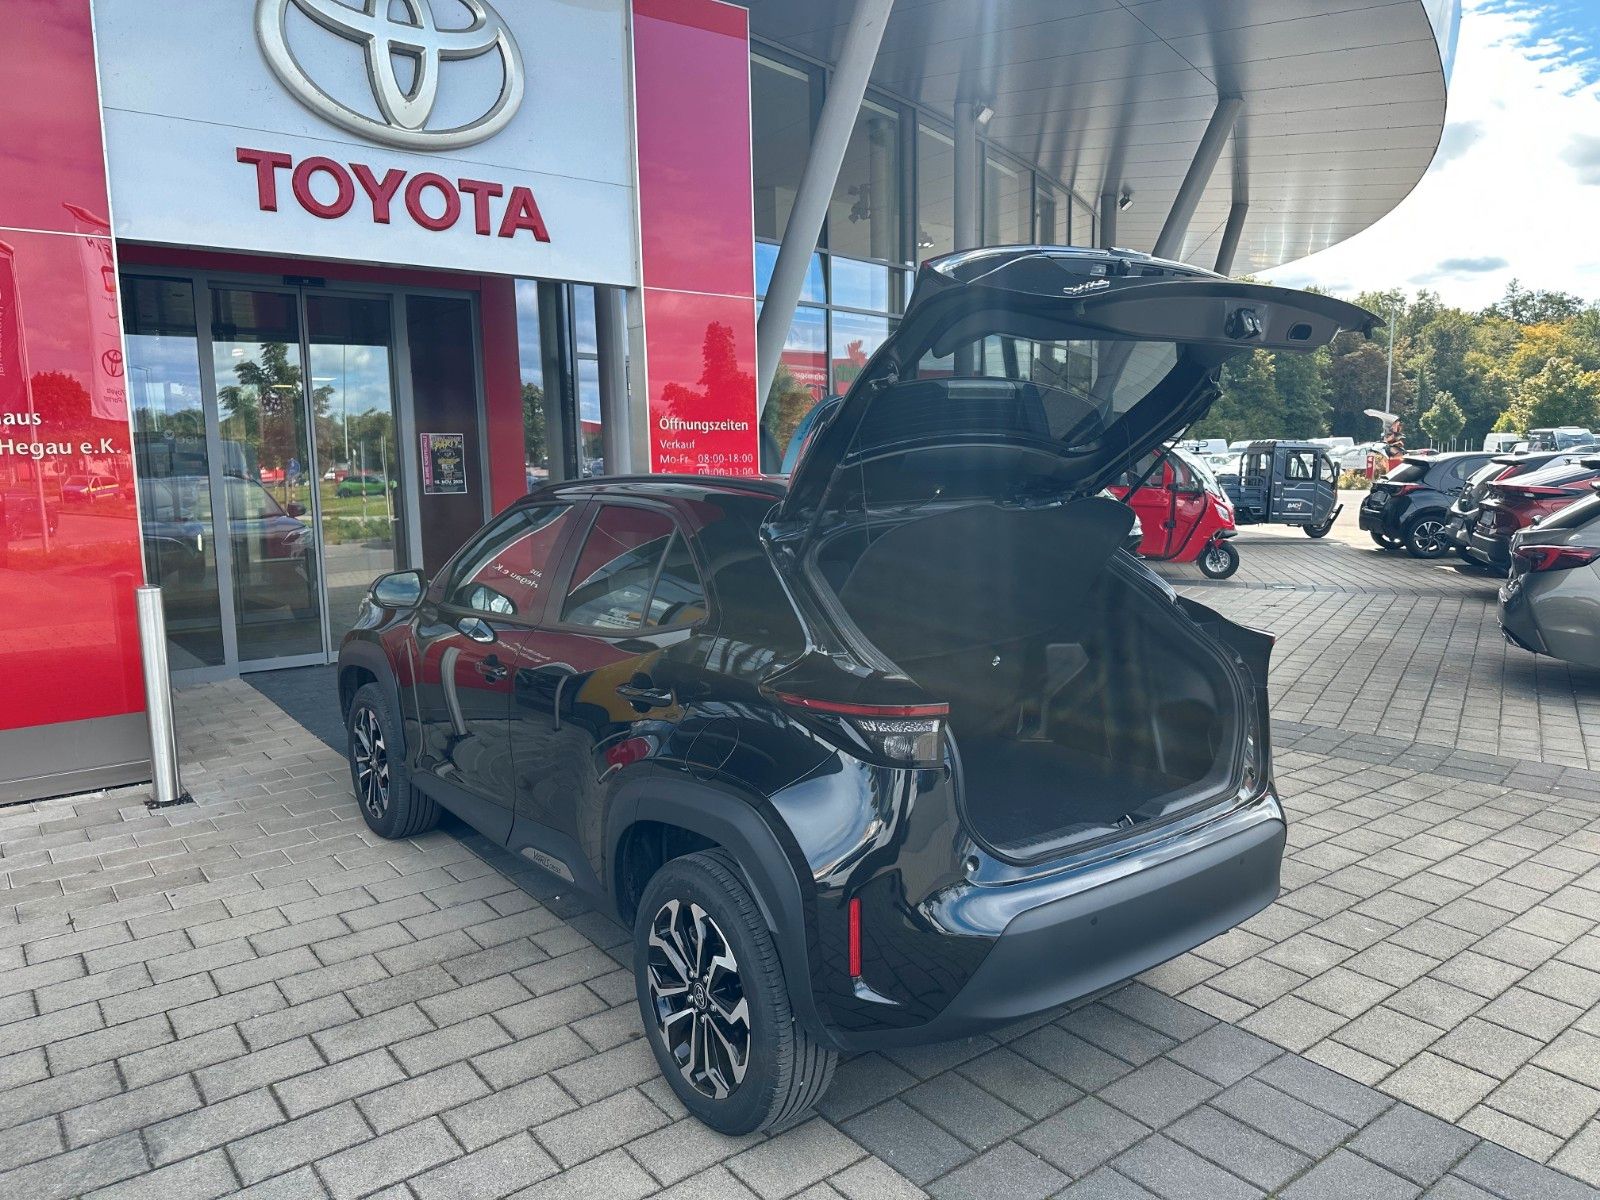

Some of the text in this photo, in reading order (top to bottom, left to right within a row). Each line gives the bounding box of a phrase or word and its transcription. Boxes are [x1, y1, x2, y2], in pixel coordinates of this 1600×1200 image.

[236, 147, 551, 243] TOYOTA
[659, 415, 749, 433] Öffnungszeiten
[0, 438, 122, 460] Hegau e.K.
[660, 439, 695, 449] Verkauf
[697, 453, 753, 464] 08:00-18:00
